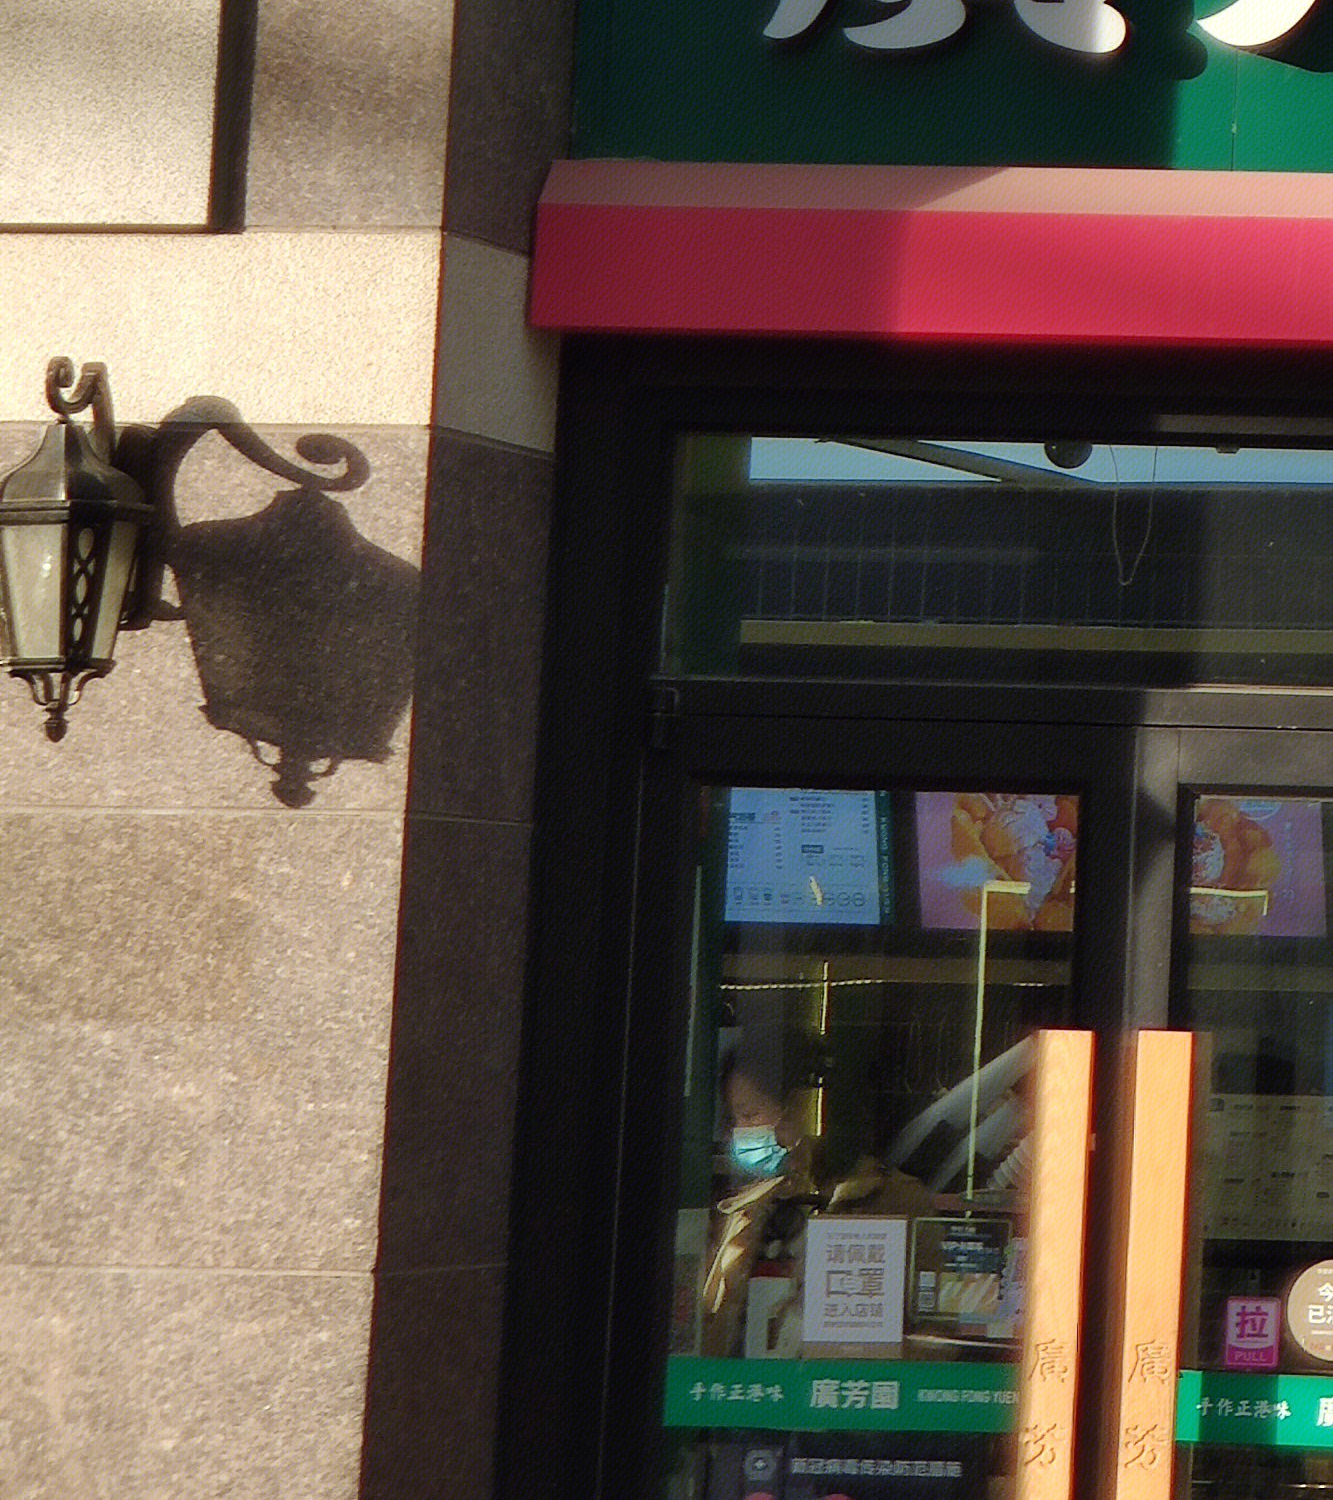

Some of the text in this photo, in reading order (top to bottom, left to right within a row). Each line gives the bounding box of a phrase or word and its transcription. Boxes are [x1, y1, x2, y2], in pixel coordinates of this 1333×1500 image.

[1236, 1305, 1269, 1339] 拉
[1235, 1351, 1267, 1362] PULL
[810, 1379, 900, 1410] 廣芳園
[1196, 1396, 1292, 1421] 手作正港味
